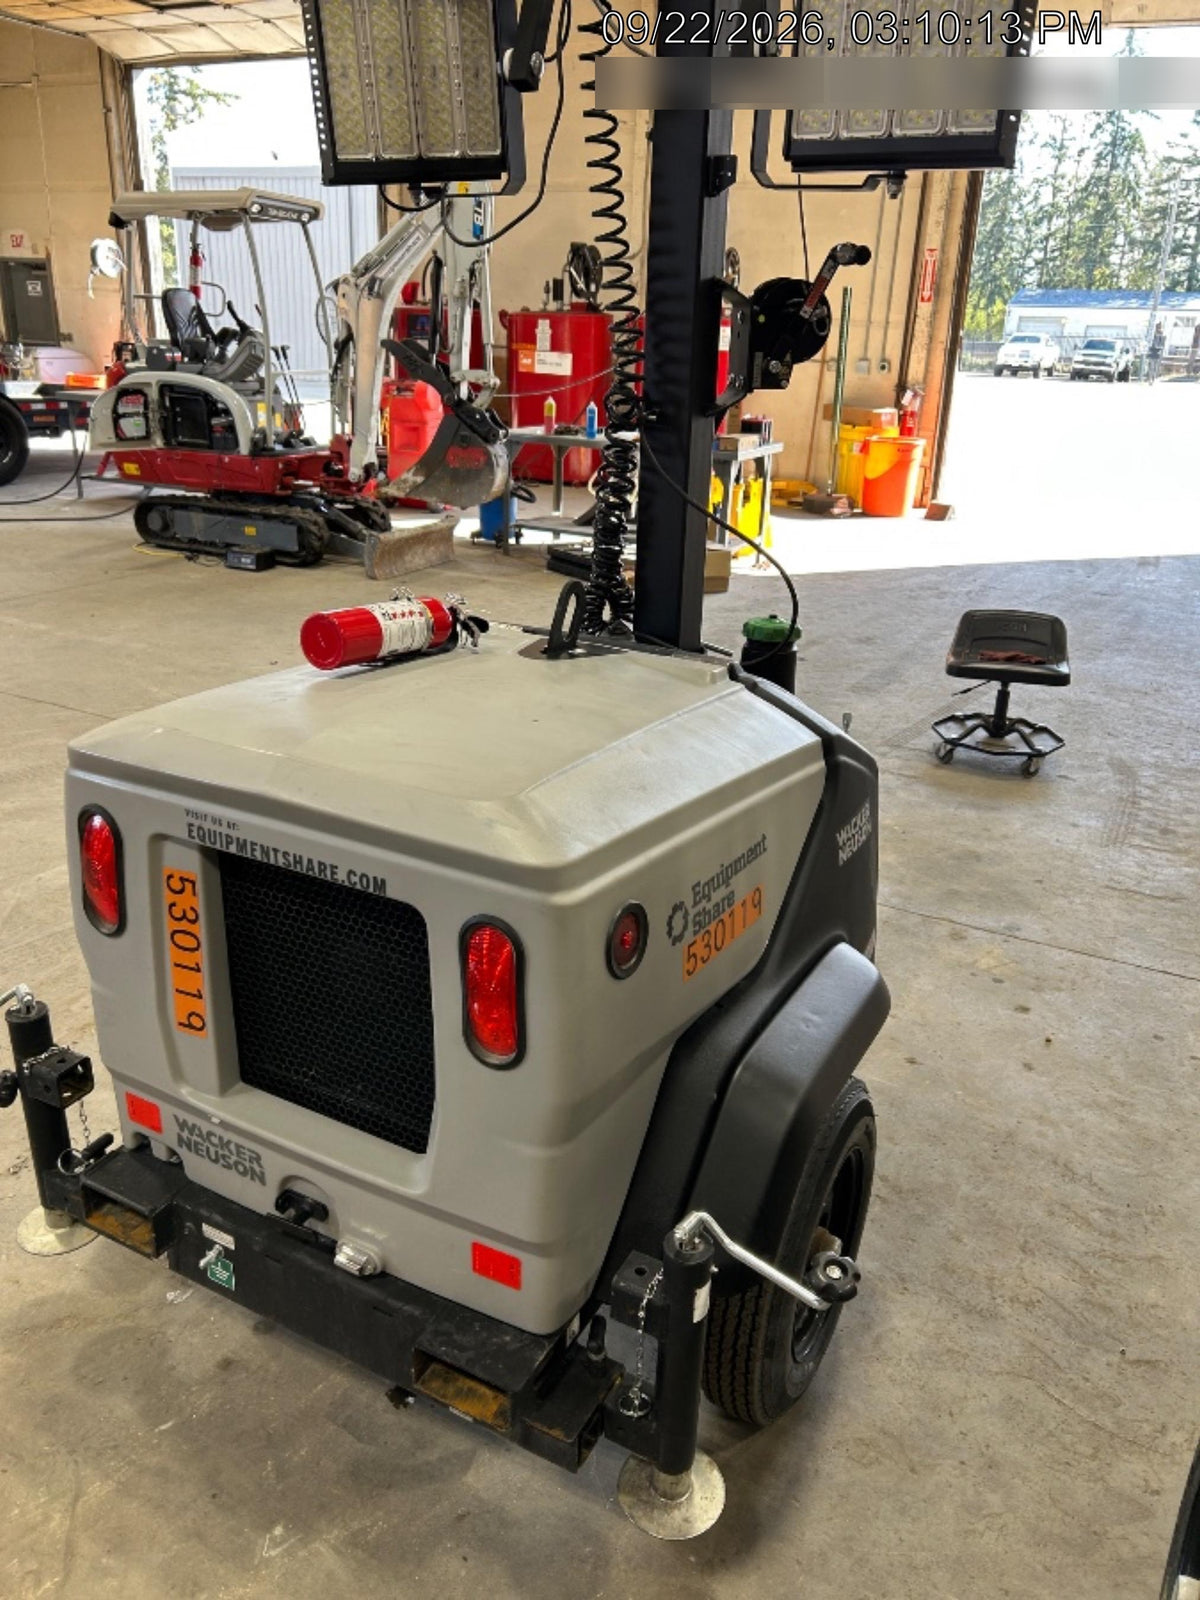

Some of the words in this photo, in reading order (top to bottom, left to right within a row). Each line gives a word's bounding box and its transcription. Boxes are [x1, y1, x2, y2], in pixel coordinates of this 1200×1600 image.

[185, 808, 208, 821] VISIT
[211, 815, 223, 827] US
[836, 801, 871, 847] WACKER
[187, 823, 388, 897] EQUIPMENTSHARE.COM
[691, 833, 768, 908] Equipment
[686, 886, 763, 976] 530119
[692, 890, 736, 936] Share
[166, 873, 206, 1032] 530119
[173, 1113, 265, 1170] WACKER
[176, 1132, 267, 1187] NEUSON
